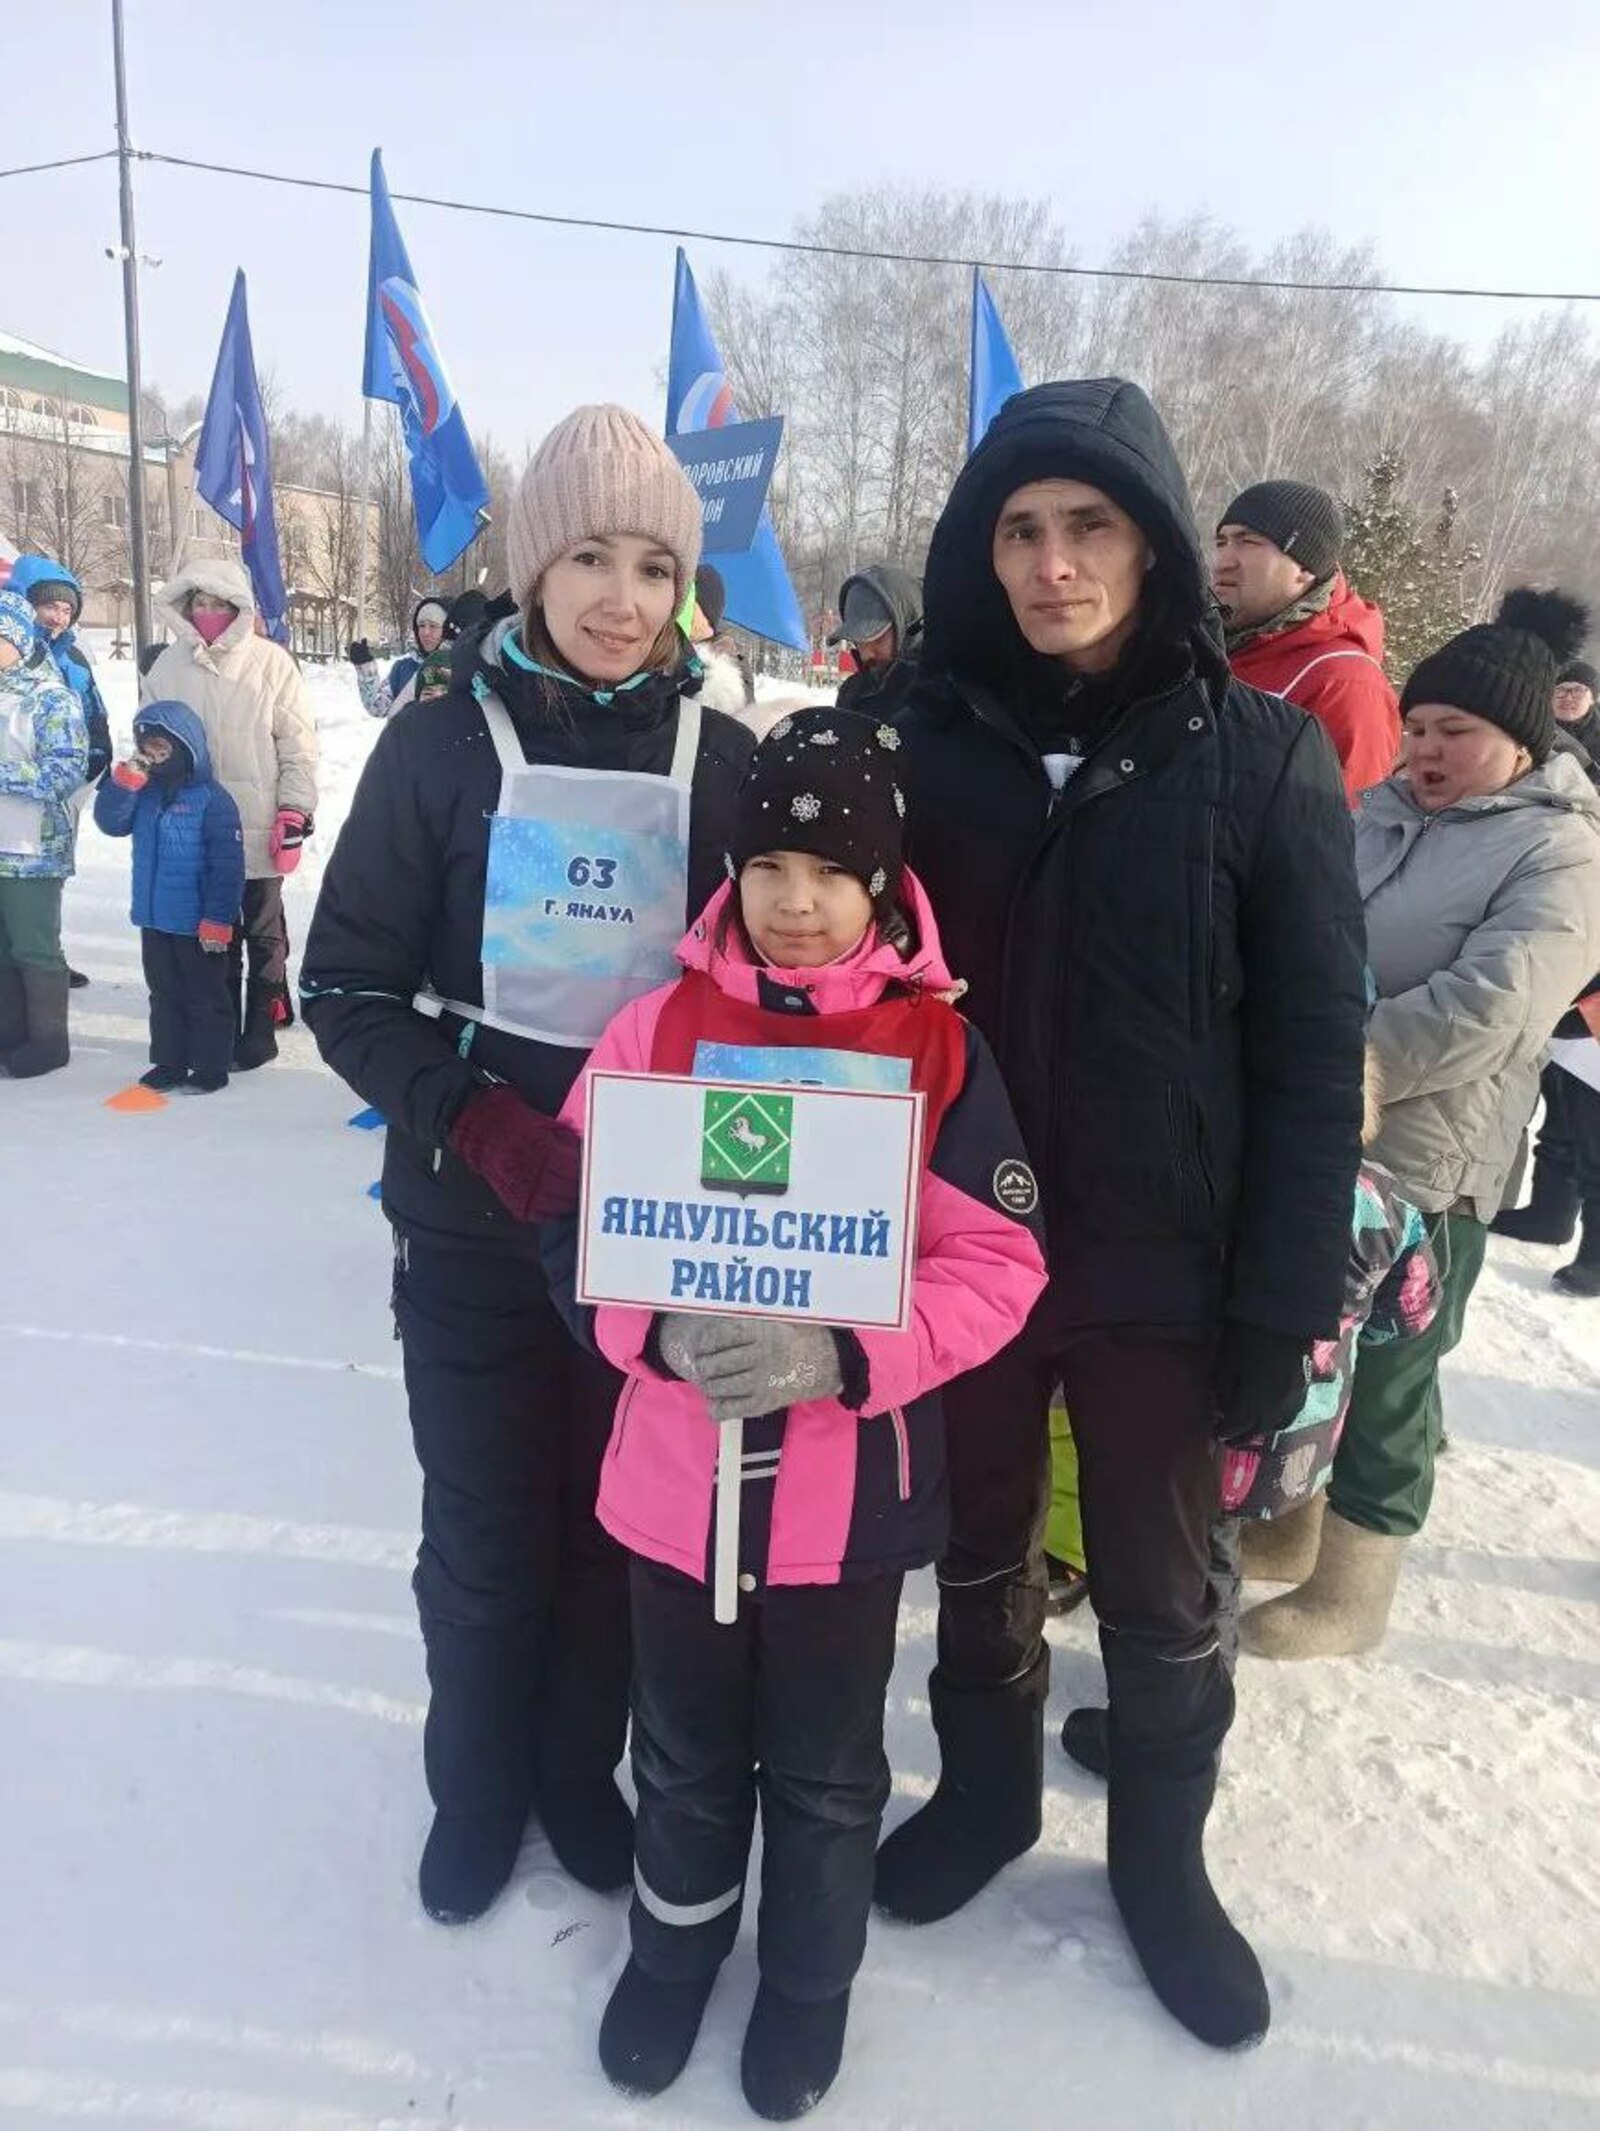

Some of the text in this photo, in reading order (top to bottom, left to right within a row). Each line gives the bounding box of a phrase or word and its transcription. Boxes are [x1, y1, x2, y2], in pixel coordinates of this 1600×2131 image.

[566, 856, 618, 890] 63
[544, 899, 635, 924] Г. ЯНАУЛ
[601, 1195, 891, 1258] ЯНАУЛЬСКИЙ
[670, 1256, 812, 1309] РАЙОН
